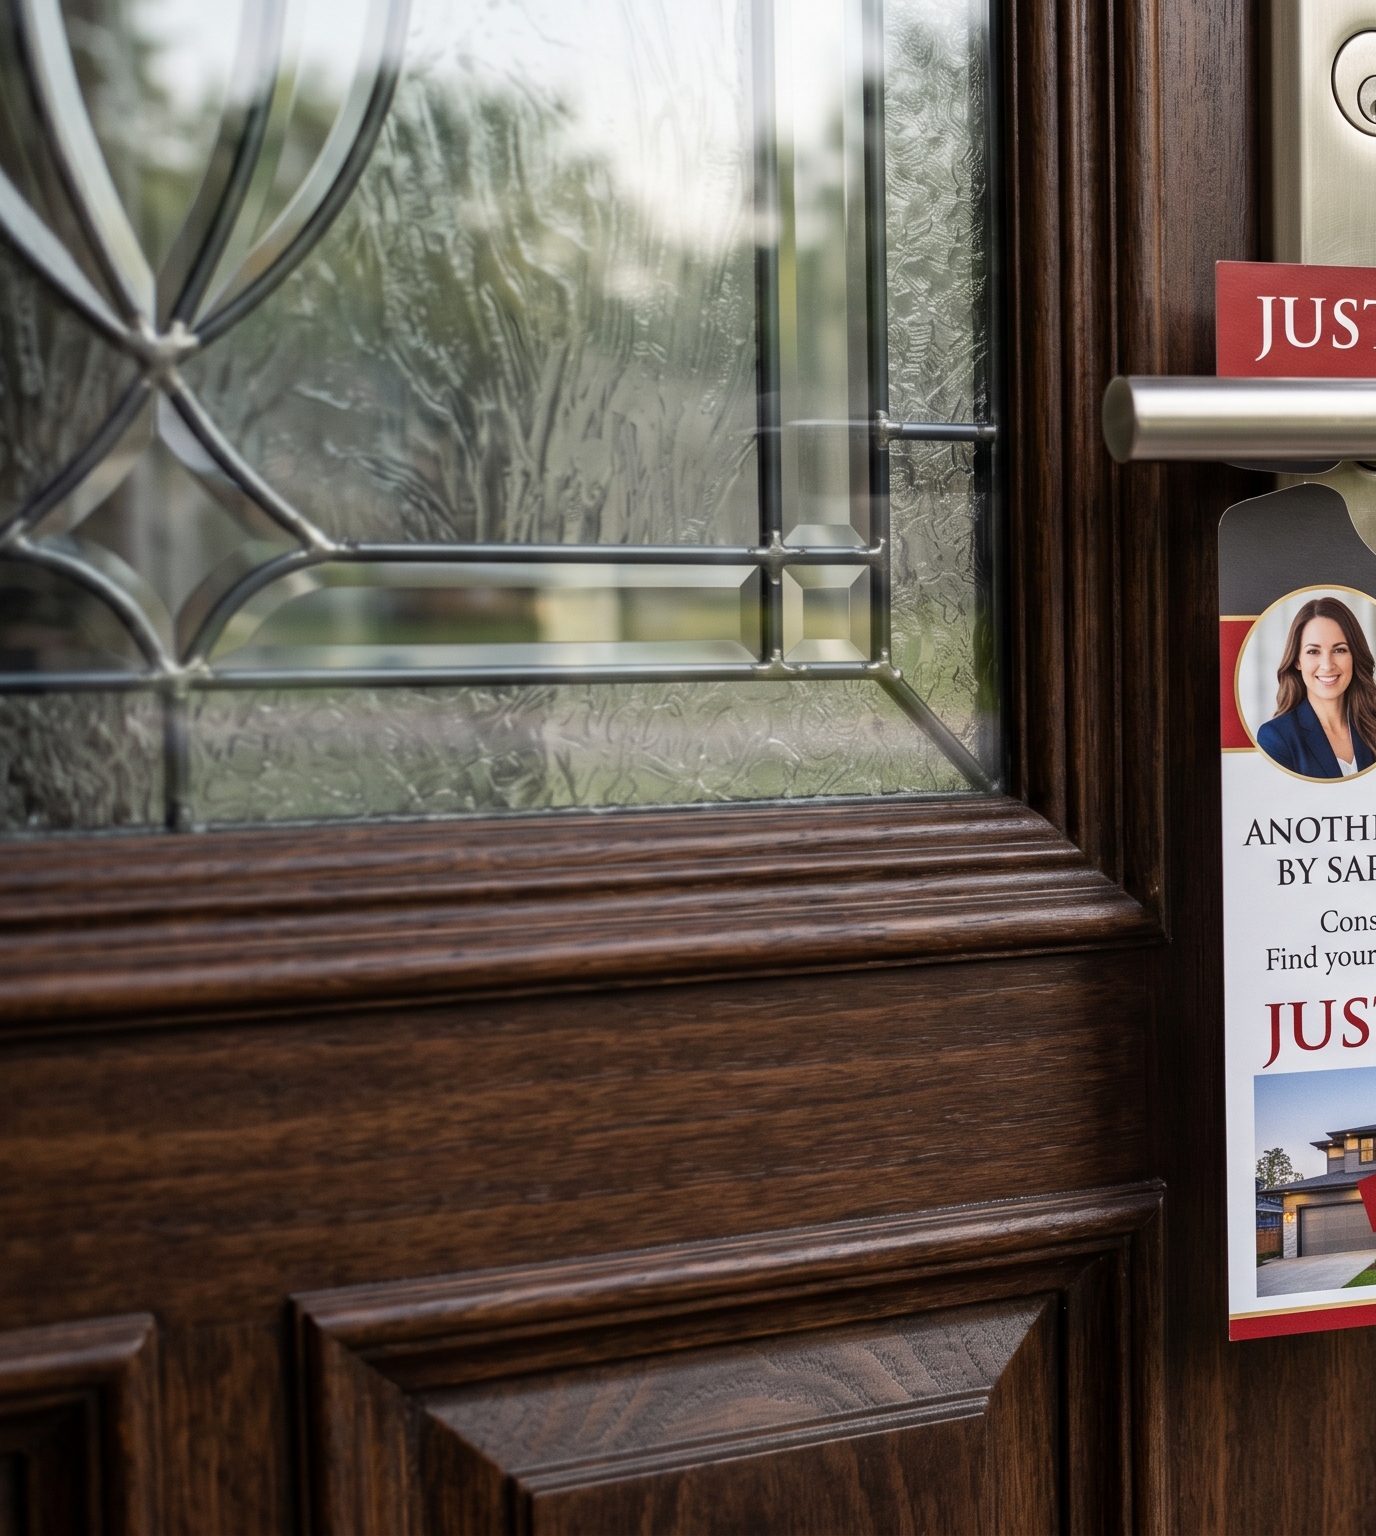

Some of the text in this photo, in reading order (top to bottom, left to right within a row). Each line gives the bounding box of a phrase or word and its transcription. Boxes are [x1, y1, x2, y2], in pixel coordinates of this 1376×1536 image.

[1277, 857, 1318, 886] BY
[1265, 945, 1318, 971] Find
[1325, 948, 1376, 976] your
